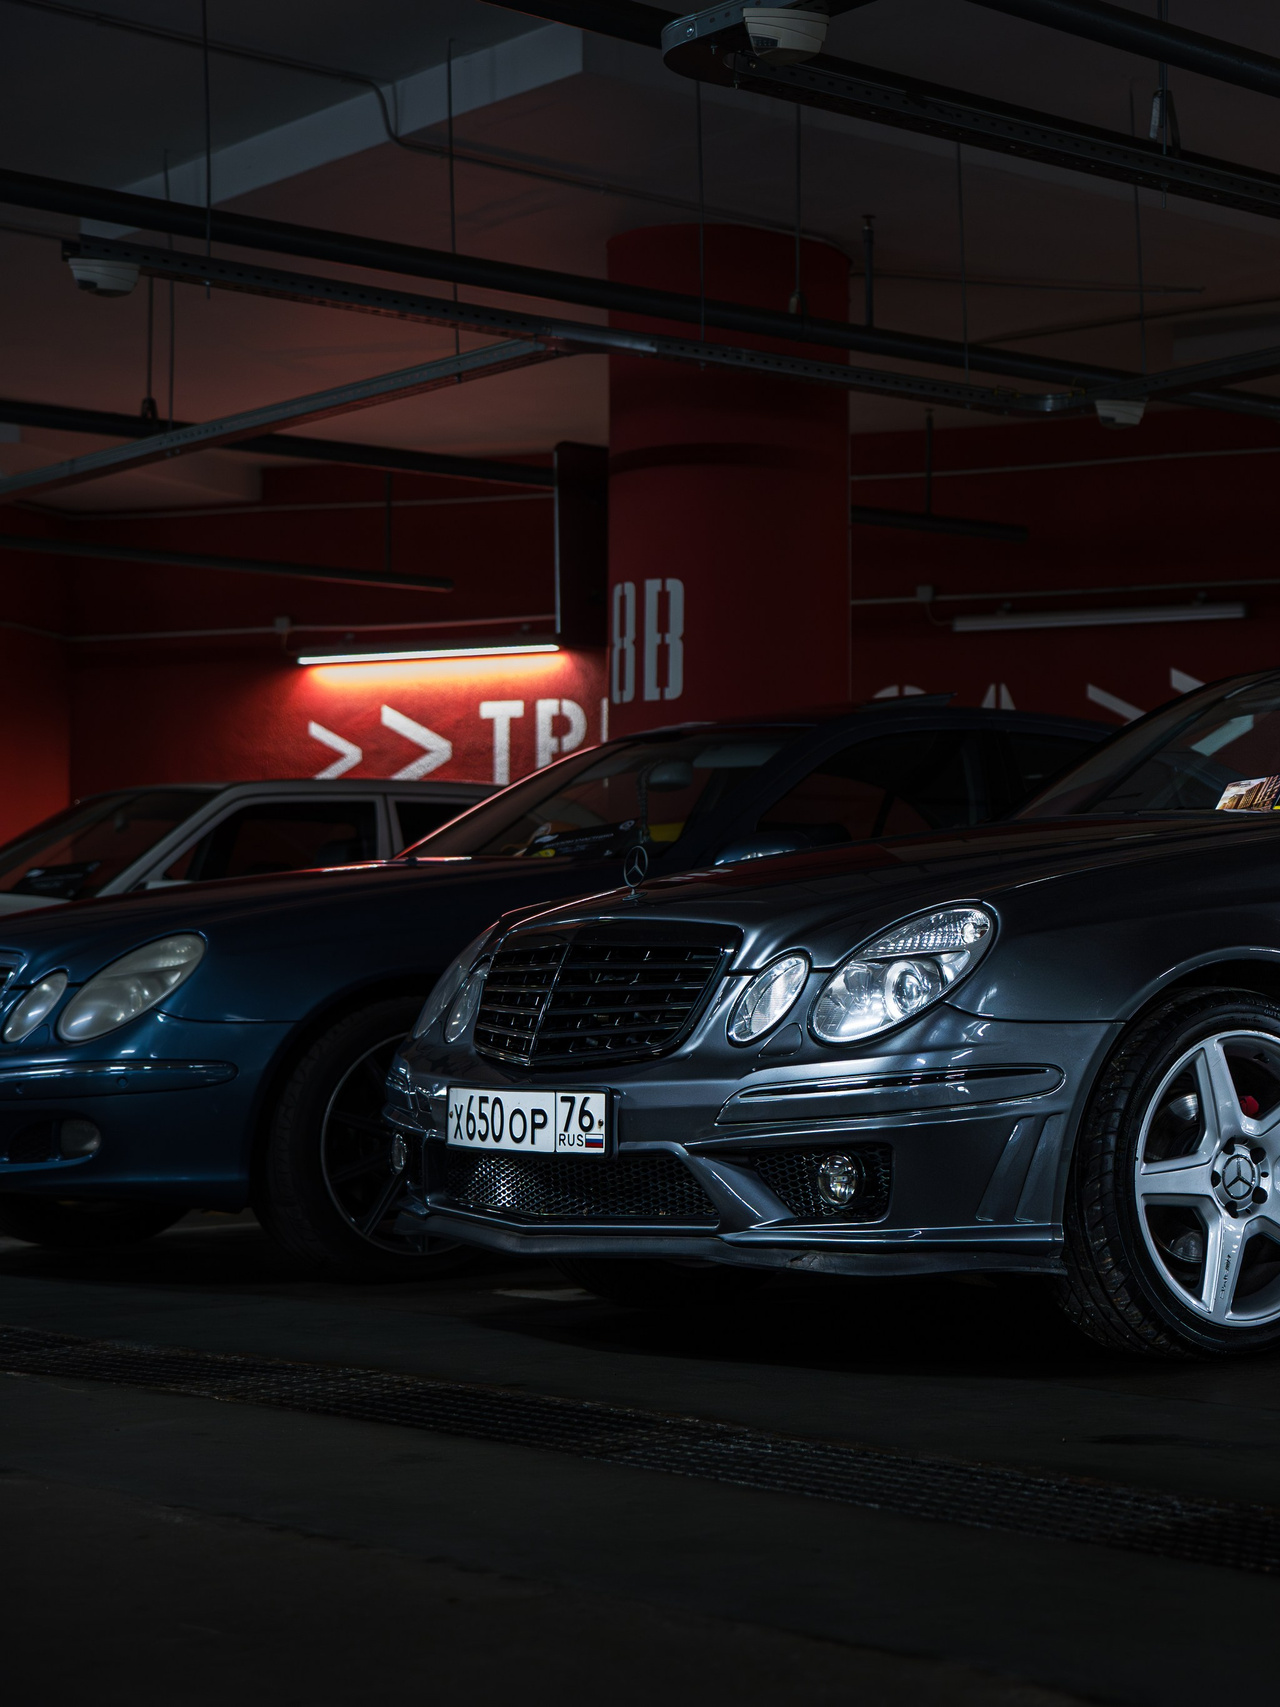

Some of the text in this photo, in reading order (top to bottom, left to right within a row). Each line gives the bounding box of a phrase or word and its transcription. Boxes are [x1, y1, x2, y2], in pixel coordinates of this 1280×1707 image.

[453, 1095, 595, 1145] Х650ОР 76
[558, 1133, 584, 1147] RUS
